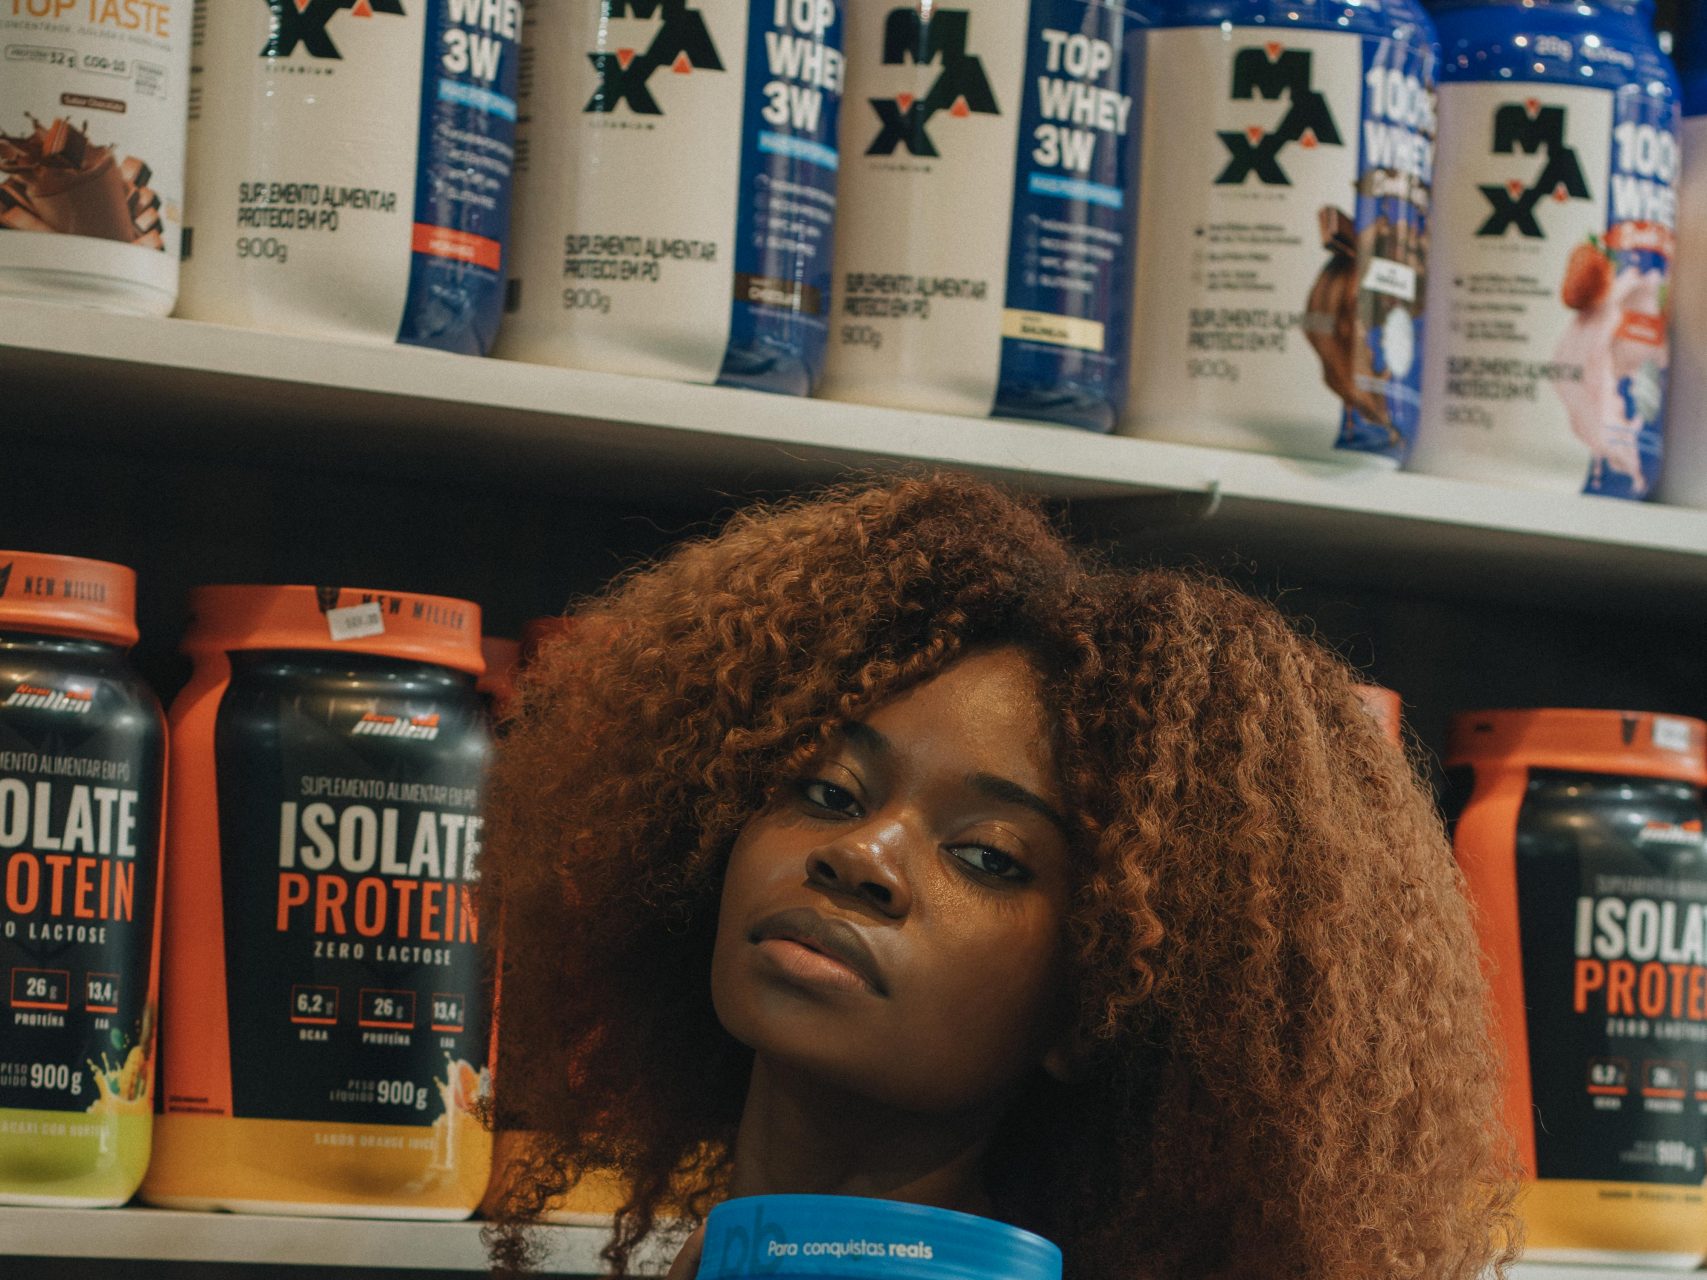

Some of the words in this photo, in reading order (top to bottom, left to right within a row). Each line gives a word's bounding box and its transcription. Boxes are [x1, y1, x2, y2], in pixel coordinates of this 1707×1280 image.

[88, 0, 170, 37] TASTE
[772, 0, 835, 36] TOP
[441, 28, 502, 82] 3W
[1041, 28, 1113, 80] TOP
[761, 80, 823, 132] 3W
[1038, 76, 1132, 136] WHEY
[1033, 124, 1096, 173] 3W
[239, 182, 320, 206] SUPLEMENTO
[322, 187, 397, 213] ALIMENTAR
[237, 206, 295, 230] PROTEICO
[297, 209, 317, 230] EM
[318, 208, 338, 231] PÓ
[236, 236, 288, 263] 900g
[564, 234, 641, 257] SUPLEMENTO
[645, 238, 717, 262] ALIMENTAR
[562, 288, 611, 314] 900g
[842, 323, 882, 349] 900g
[25, 576, 55, 596] NEW
[38, 754, 101, 779] ALIMENTAR
[301, 776, 385, 800] SUPLEMENTO
[387, 782, 447, 805] ALIMENTAR
[0, 778, 138, 857] OLATE
[278, 801, 484, 881] ISOLATE
[6, 852, 135, 922] OTEIN
[276, 872, 481, 945] PROTEIN
[29, 922, 107, 944] LACTOSE
[314, 941, 364, 960] ZERO
[376, 945, 451, 966] LACTOSE
[26, 977, 47, 997] 26
[297, 994, 323, 1013] 6,2
[374, 998, 394, 1017] 26
[14, 1012, 65, 1027] PROTEÍNA
[362, 1032, 411, 1046] PROTEÍNA
[31, 1063, 83, 1096] 900g
[377, 1080, 428, 1111] 900g
[767, 1240, 798, 1257] Para
[803, 1238, 886, 1259] conquistas
[888, 1241, 933, 1260] reais
